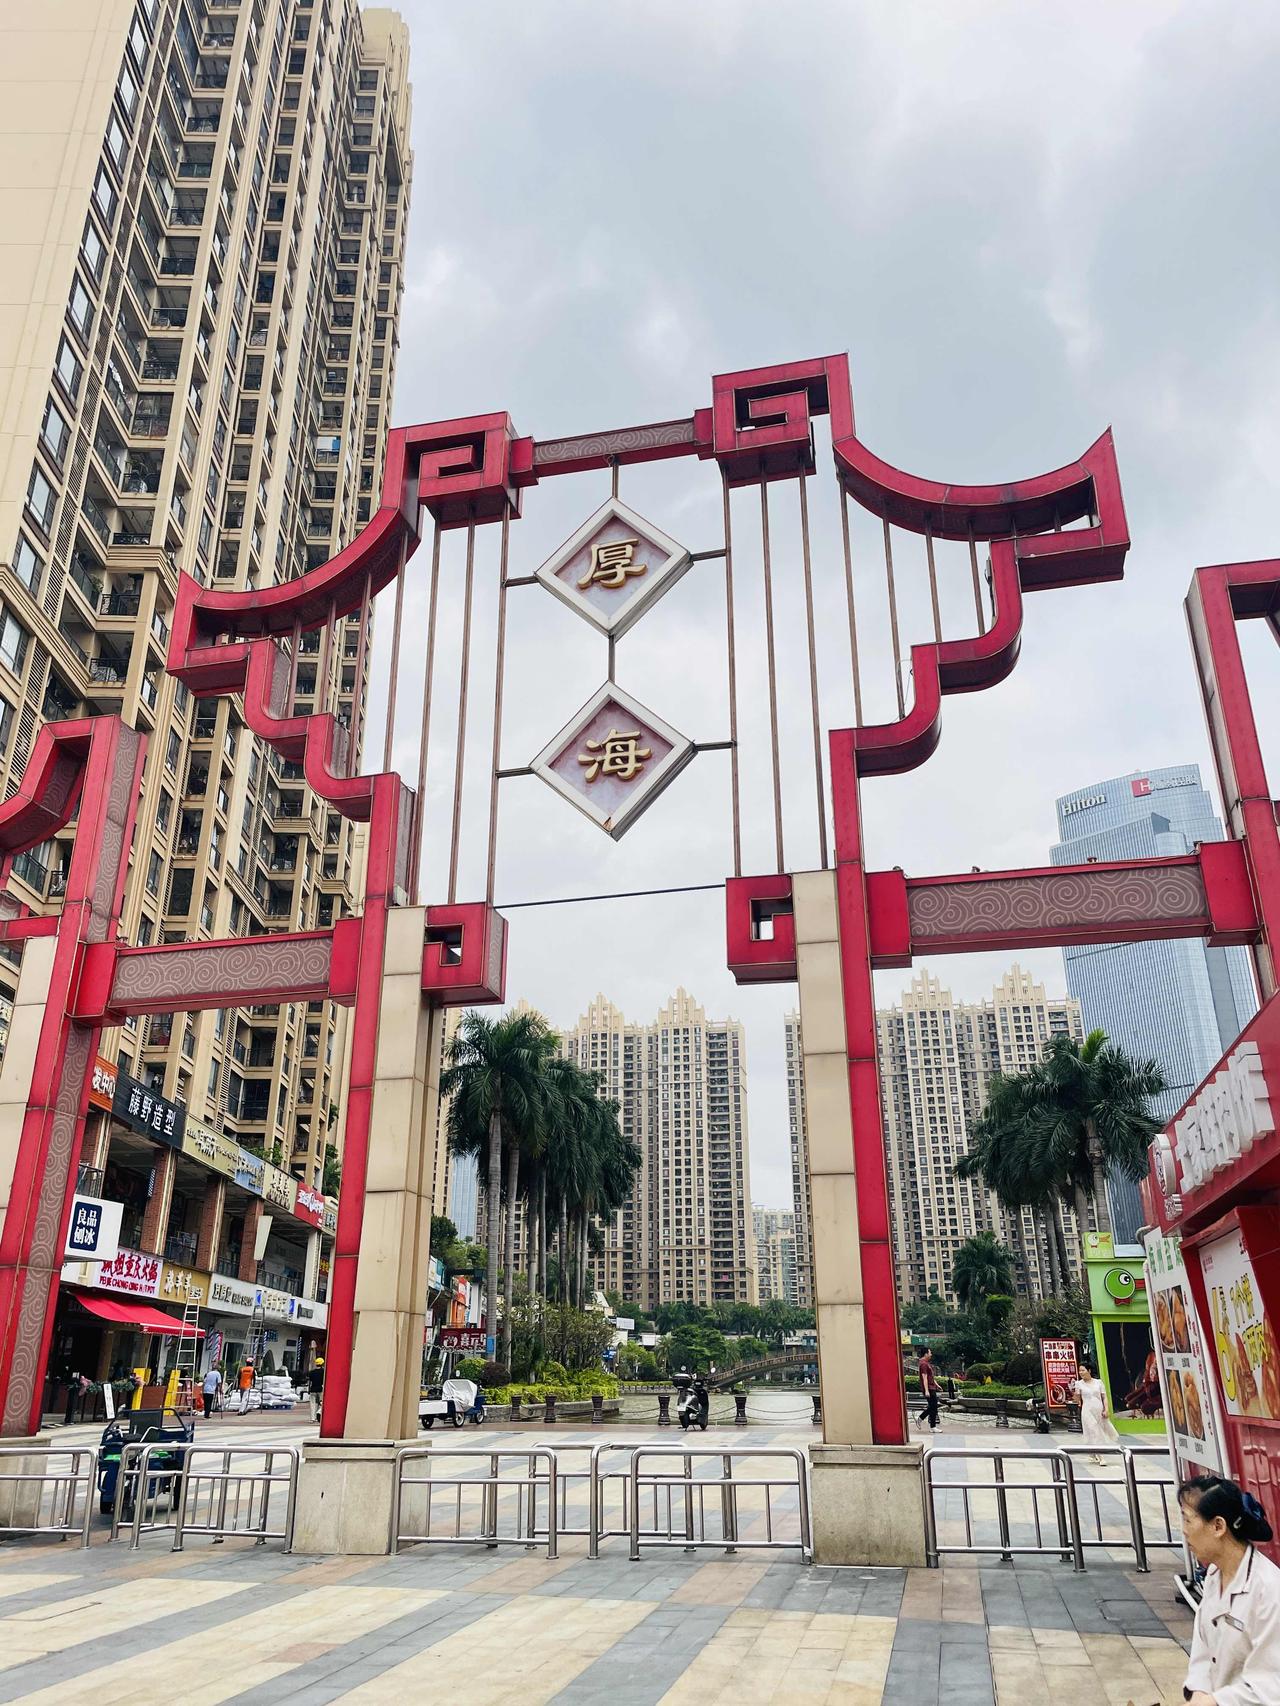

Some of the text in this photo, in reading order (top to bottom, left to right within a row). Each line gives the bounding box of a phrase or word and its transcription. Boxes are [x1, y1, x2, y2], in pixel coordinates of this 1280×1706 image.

[577, 539, 648, 589] 厚
[578, 729, 652, 782] 海
[1062, 795, 1106, 816] Hilton
[128, 1086, 176, 1136] 藤野造型
[77, 1208, 97, 1227] 良品
[73, 1226, 95, 1245] 刨冰
